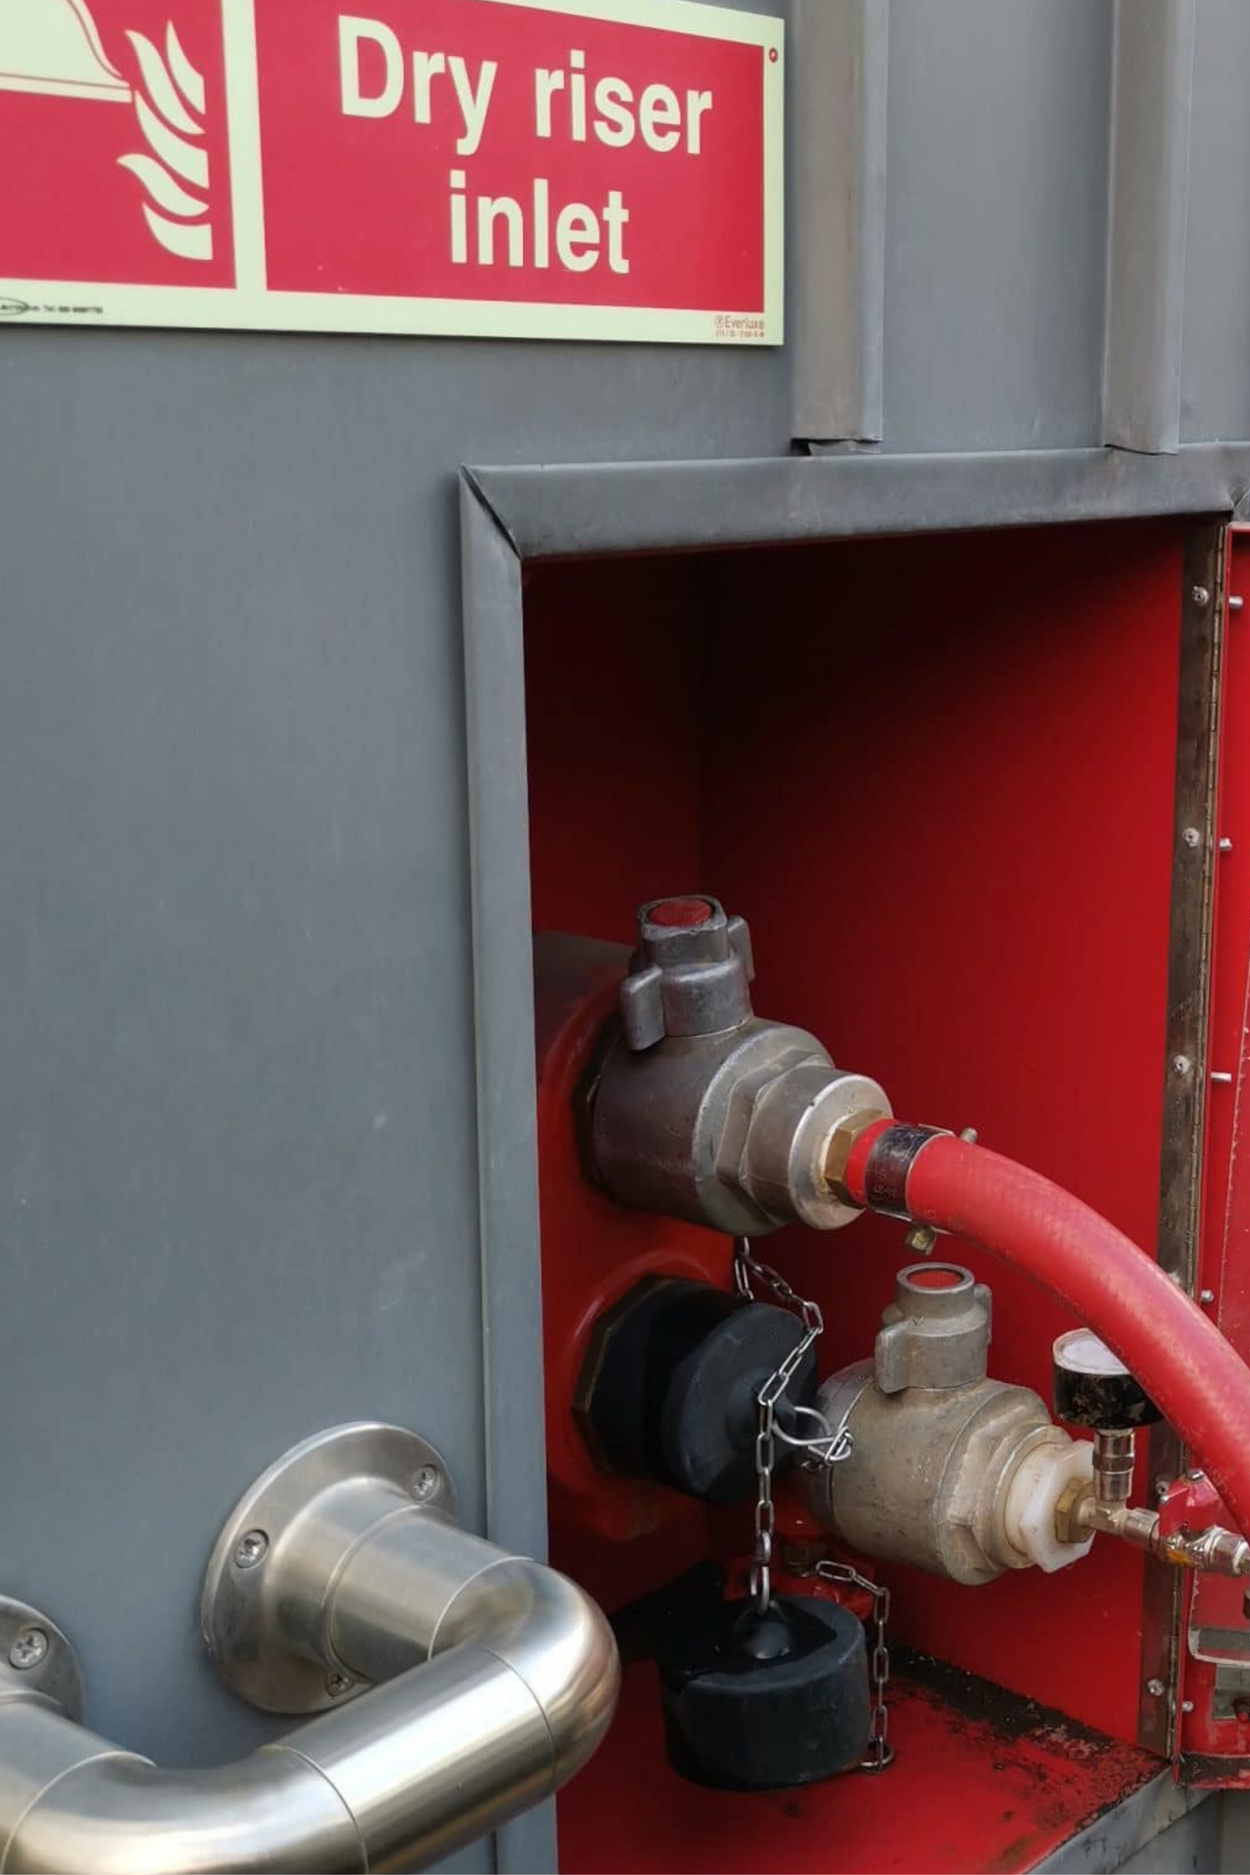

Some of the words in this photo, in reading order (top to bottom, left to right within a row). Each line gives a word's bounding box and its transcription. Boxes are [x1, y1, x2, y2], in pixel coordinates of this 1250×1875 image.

[338, 15, 498, 156] Dry
[535, 50, 713, 154] riser
[450, 170, 630, 274] inlet
